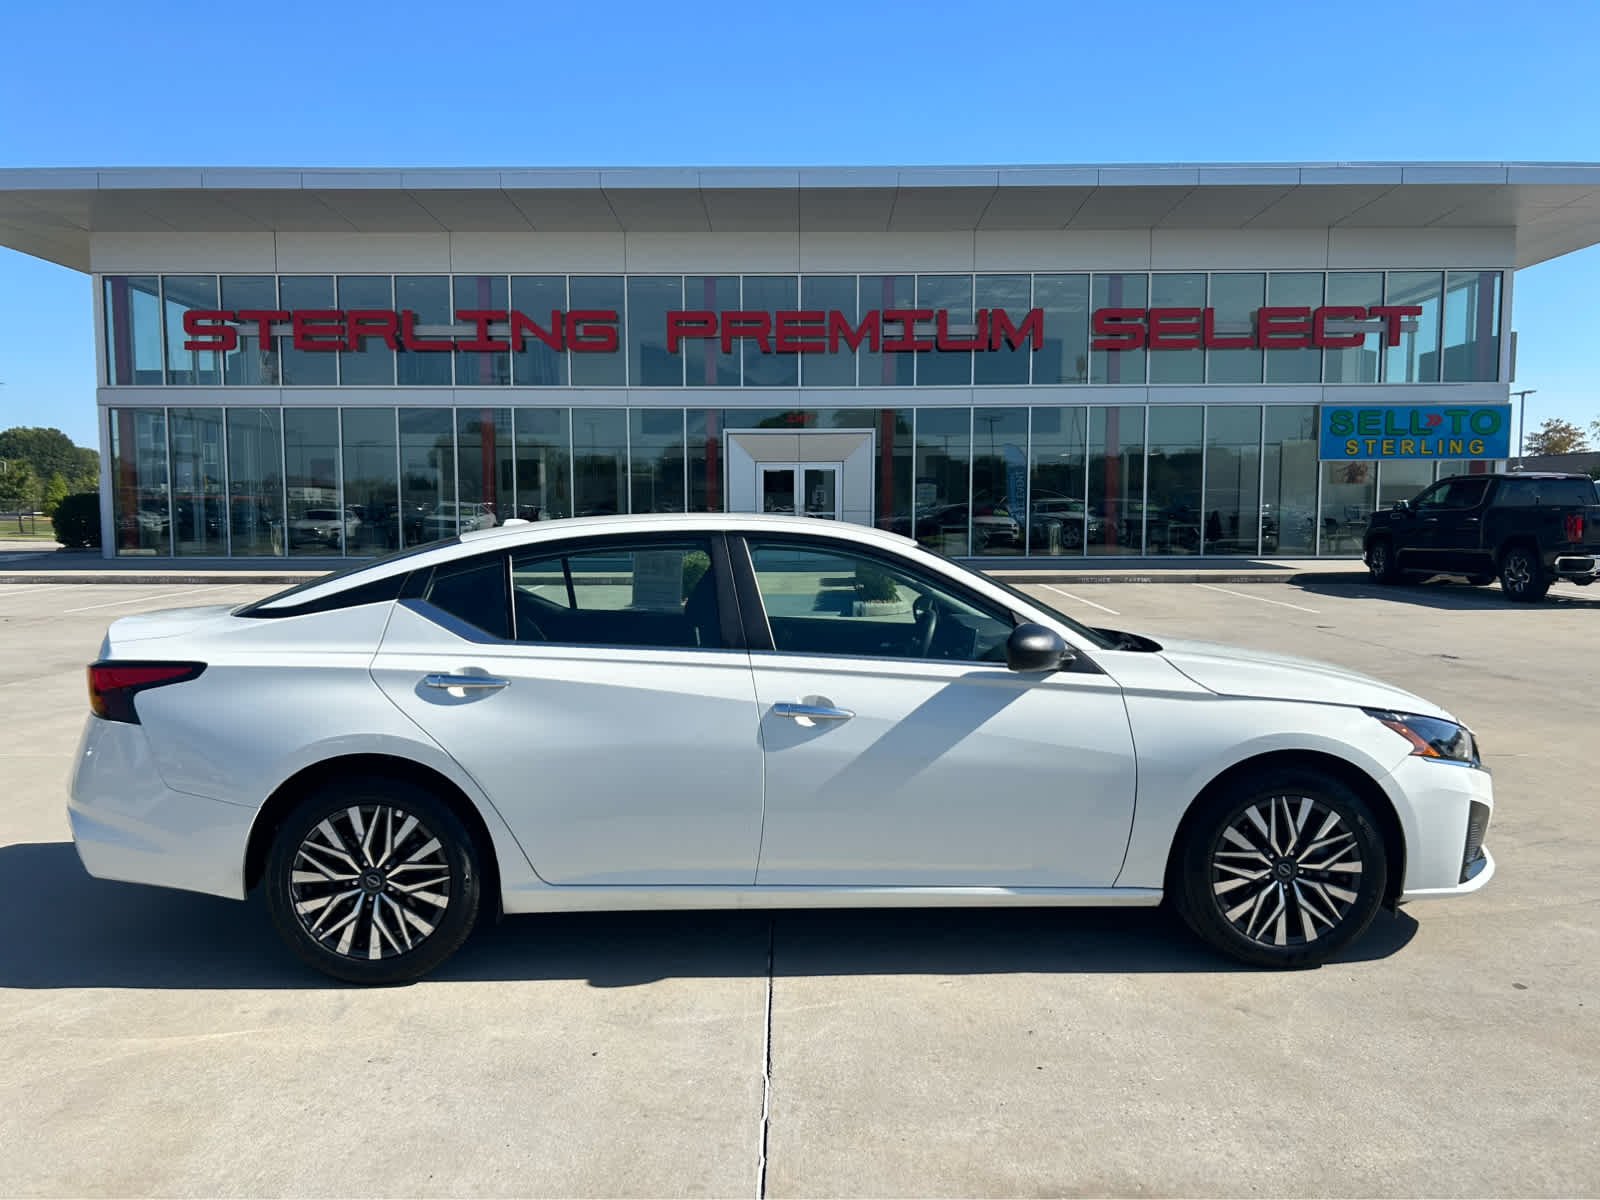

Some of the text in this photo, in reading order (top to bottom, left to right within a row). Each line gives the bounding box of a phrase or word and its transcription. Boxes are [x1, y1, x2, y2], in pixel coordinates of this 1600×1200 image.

[183, 305, 1422, 353] STERLING PREMIUM SELECT
[1329, 408, 1502, 436] SELL TO
[1345, 438, 1486, 456] STERLING
